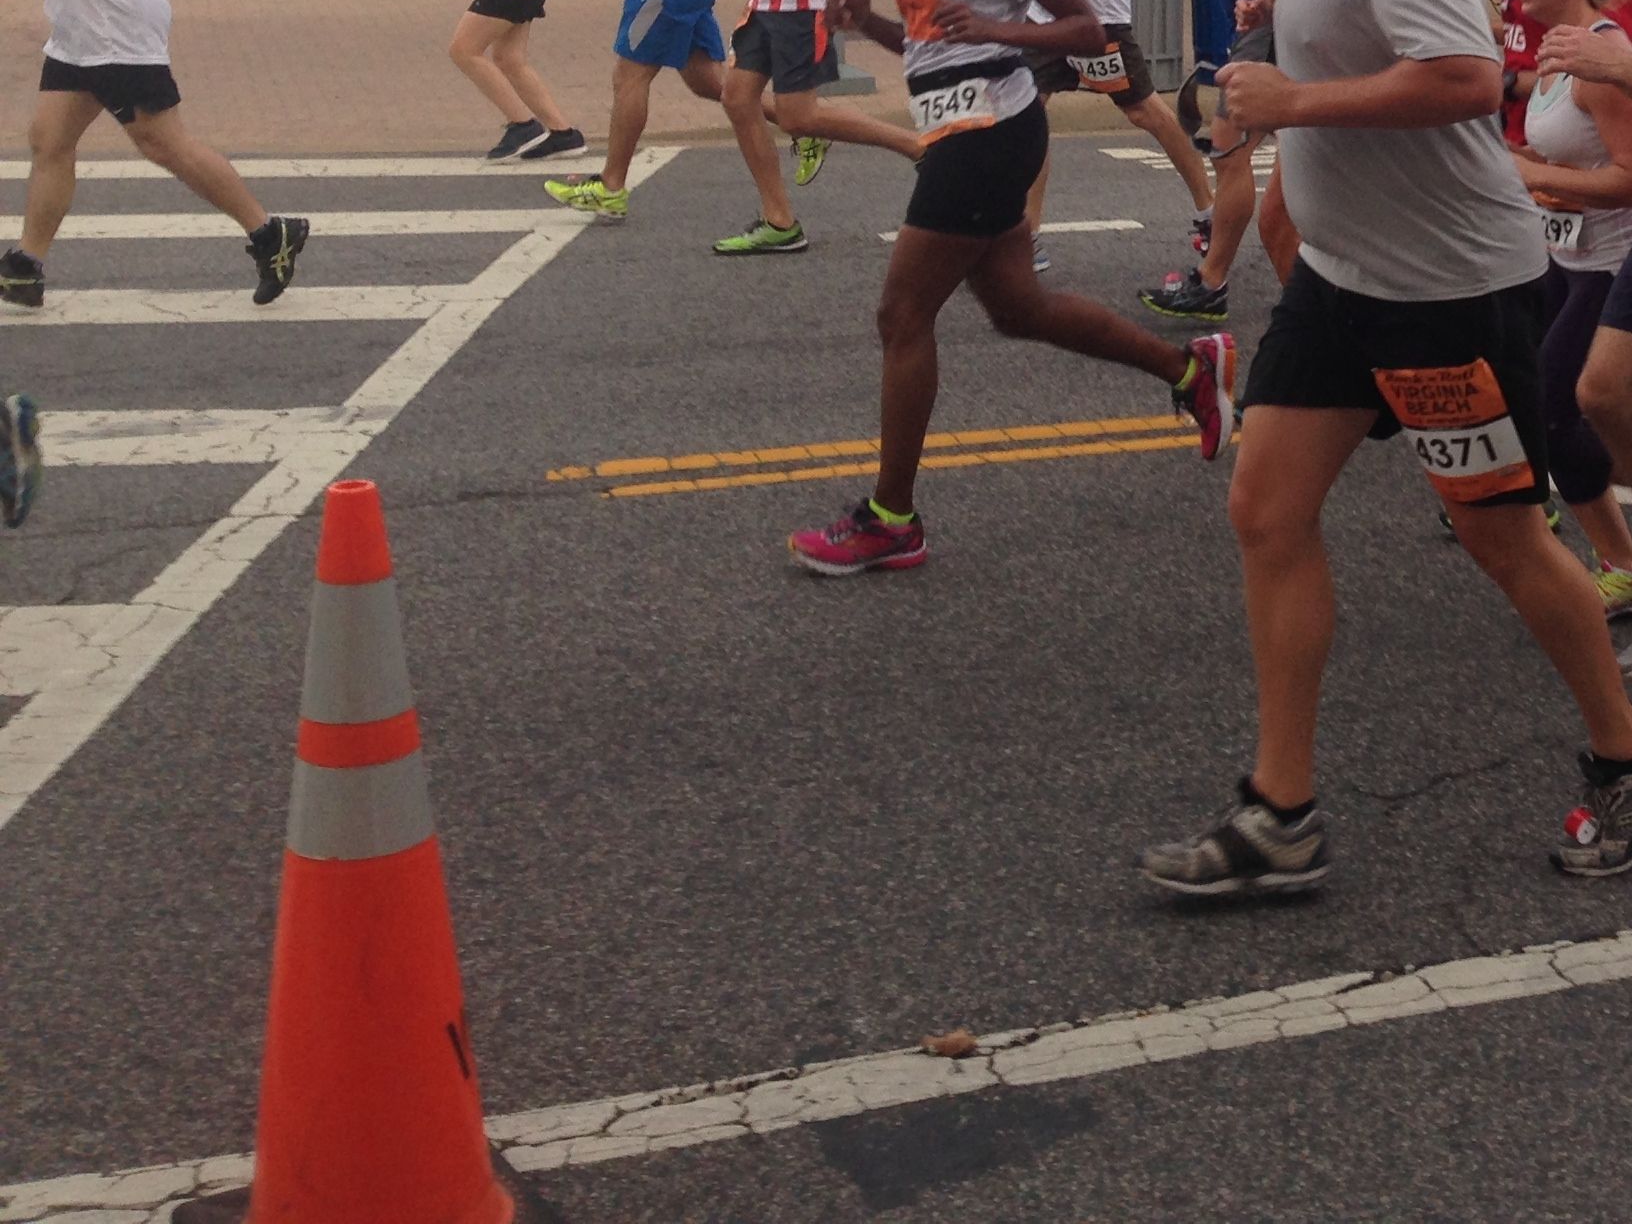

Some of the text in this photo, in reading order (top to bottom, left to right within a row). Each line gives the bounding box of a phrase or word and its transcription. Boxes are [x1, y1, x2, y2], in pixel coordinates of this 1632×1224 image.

[1076, 57, 1121, 78] 1435
[919, 87, 977, 126] 7549
[1391, 380, 1481, 401] VIRGINIA
[1405, 397, 1473, 416] BEACH
[1415, 433, 1499, 470] 4371
